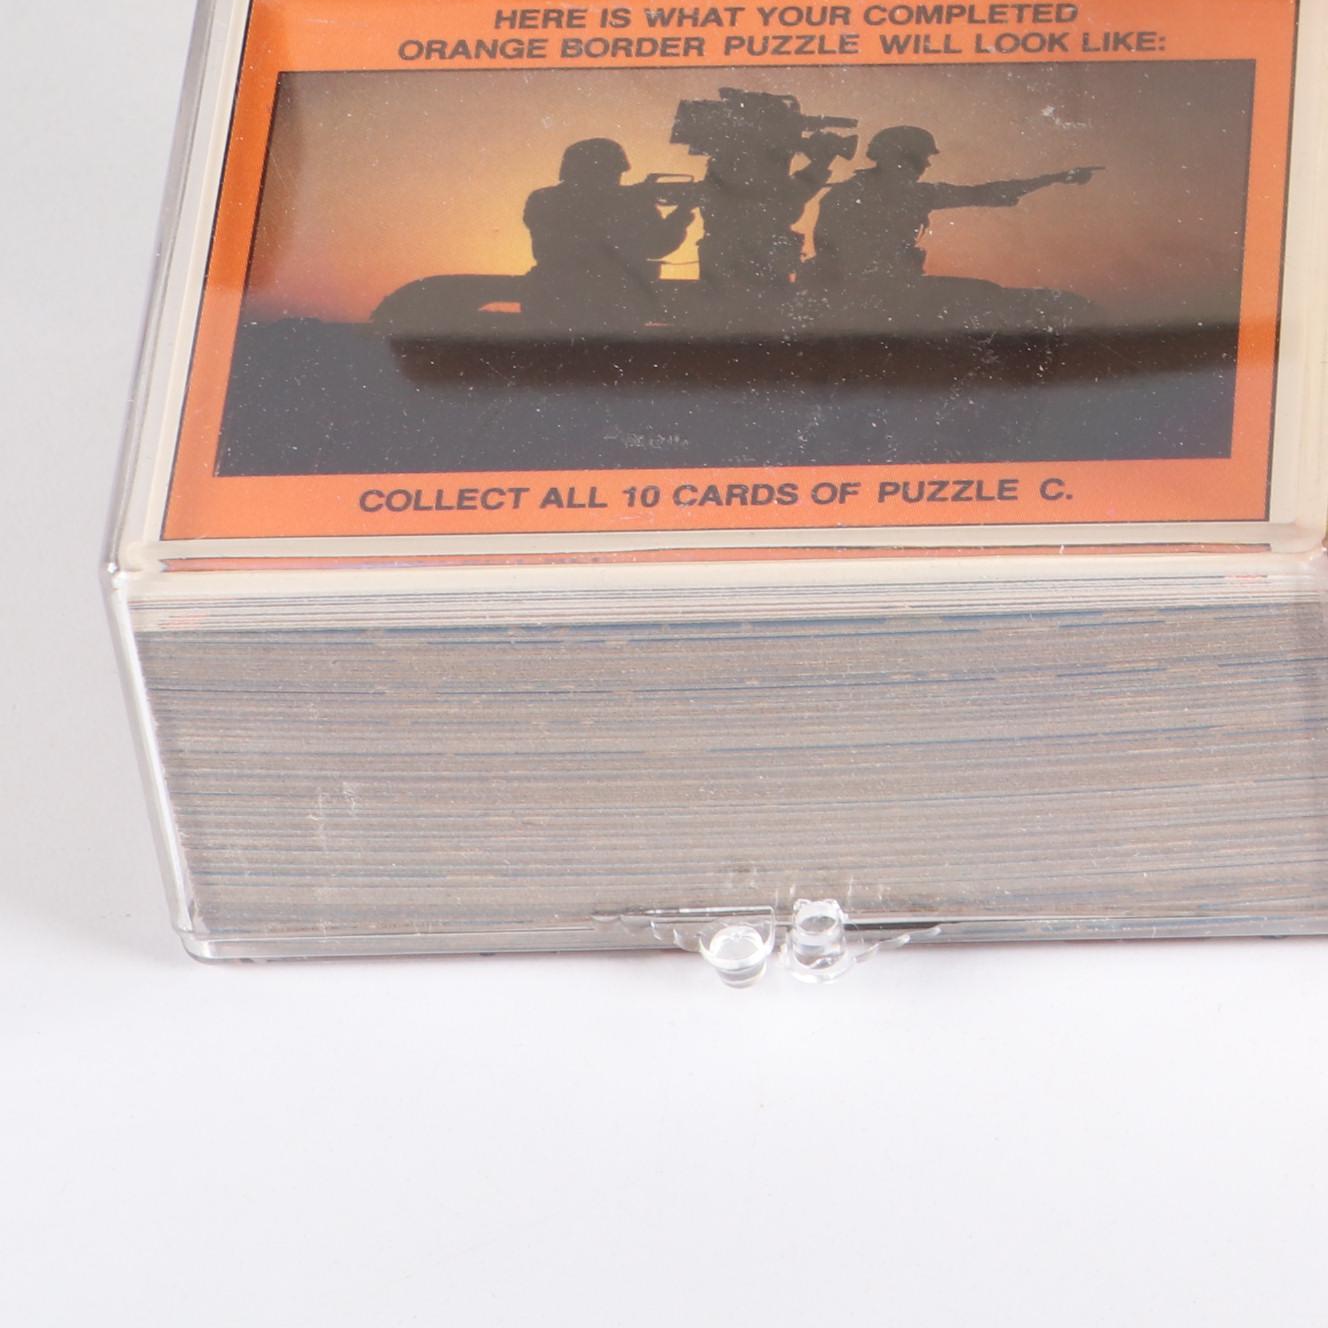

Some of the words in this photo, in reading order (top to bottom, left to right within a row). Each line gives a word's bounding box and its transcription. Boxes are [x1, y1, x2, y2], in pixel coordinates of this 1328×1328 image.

[494, 8, 586, 29] HERE
[599, 7, 631, 28] IS
[645, 6, 745, 27] WHAT
[756, 5, 851, 26] YOUR
[863, 3, 1079, 25] COMPLETED
[398, 38, 548, 61] ORANGE
[560, 36, 705, 58] BORDER
[724, 34, 859, 56] PUZZLE
[880, 33, 962, 54] WILL
[975, 32, 1070, 54] LOOK
[1082, 31, 1166, 53] LIKE:
[359, 487, 529, 512] COLLECT
[539, 486, 609, 510] ALL
[622, 485, 661, 509] 10
[672, 483, 799, 507] CARDS
[811, 482, 861, 505] OF
[877, 478, 1019, 504] PUZZLE
[1039, 478, 1074, 501] C.
